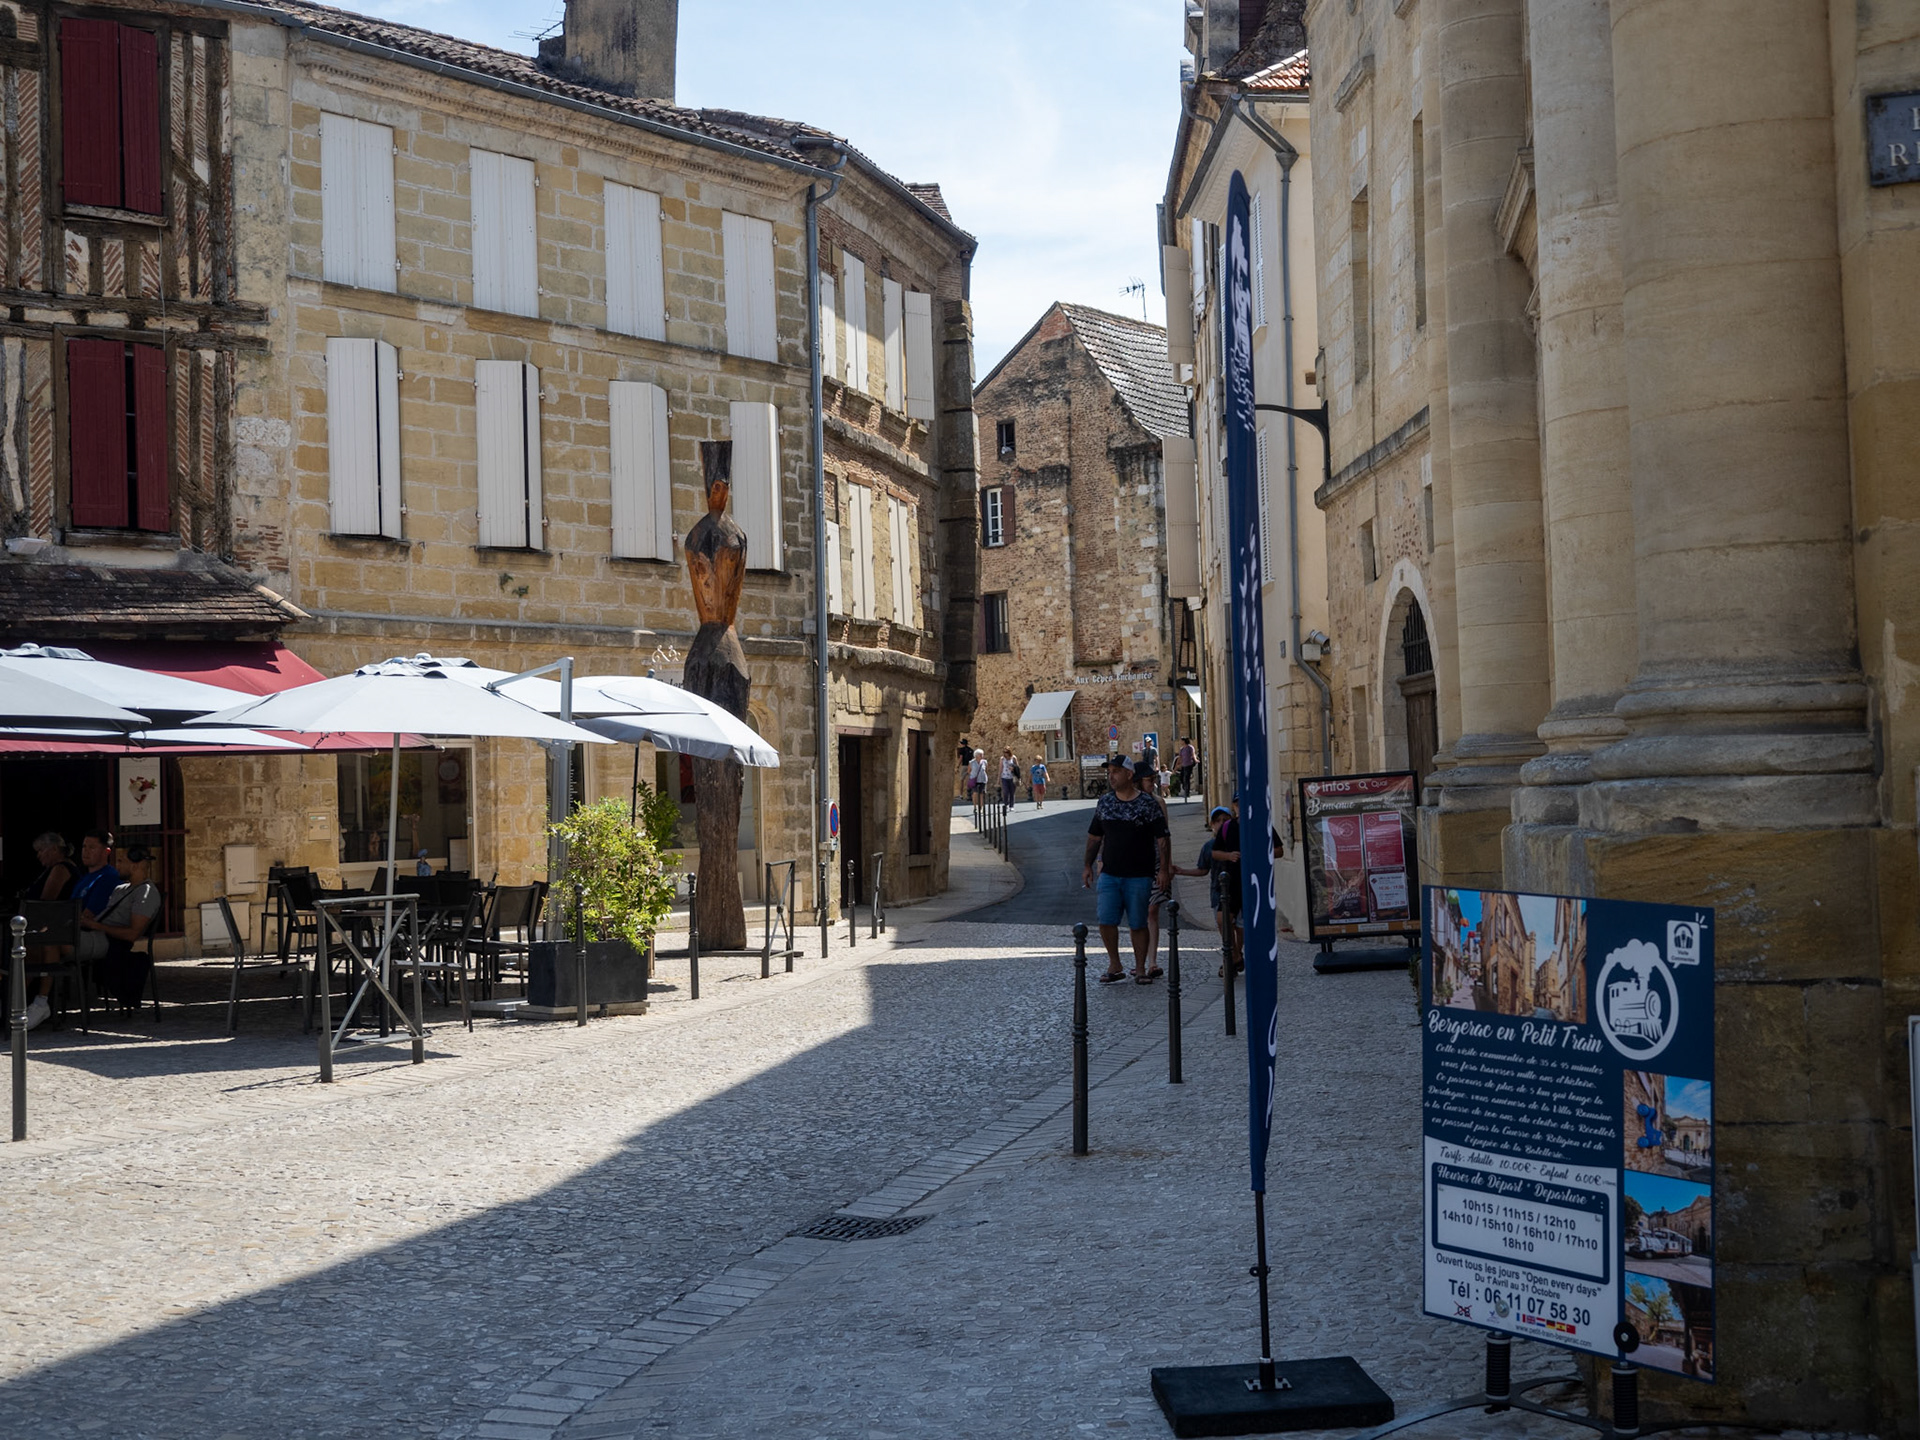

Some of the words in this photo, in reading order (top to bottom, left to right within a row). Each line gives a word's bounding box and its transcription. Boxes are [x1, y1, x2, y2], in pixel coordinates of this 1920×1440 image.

[1428, 1009, 1493, 1043] Bergerac
[1497, 1026, 1515, 1041] en
[1521, 1022, 1557, 1046] Petit
[1562, 1025, 1604, 1053] Train
[1435, 1043, 1455, 1053] Cette
[1457, 1048, 1477, 1056] visite
[1479, 1052, 1524, 1063] commentée
[1526, 1056, 1537, 1064] de
[1570, 1064, 1603, 1075] minutes
[1441, 1061, 1458, 1069] vous
[1460, 1061, 1478, 1072] fera
[1480, 1064, 1515, 1076] traverser
[1516, 1070, 1536, 1079] mille
[1539, 1075, 1553, 1083] ans
[1436, 1072, 1446, 1080] Ce
[1446, 1076, 1482, 1087] parcours
[1484, 1079, 1494, 1088] de
[1495, 1082, 1514, 1092] plus
[1516, 1084, 1526, 1093] de
[1536, 1087, 1550, 1096] km
[1552, 1092, 1567, 1101] qui
[1568, 1092, 1591, 1106] longe
[1594, 1096, 1603, 1105] la
[1432, 1100, 1440, 1109] la
[1443, 1102, 1469, 1113] Guerre
[1471, 1107, 1481, 1115] de
[1518, 1114, 1530, 1123] du
[1560, 1121, 1575, 1131] des
[1578, 1124, 1616, 1138] Récollets
[1471, 1094, 1489, 1102] vous
[1528, 1101, 1538, 1110] de
[1541, 1103, 1550, 1112] la
[1553, 1105, 1572, 1115] Villa
[1575, 1108, 1612, 1121] Romaine
[1442, 1119, 1474, 1131] passant
[1472, 1122, 1489, 1132] par
[1491, 1124, 1500, 1133] la
[1502, 1126, 1529, 1138] Guerre
[1532, 1132, 1542, 1140] de
[1546, 1134, 1580, 1148] Religion
[1582, 1140, 1592, 1148] et
[1593, 1142, 1604, 1151] de
[1500, 1141, 1510, 1149] de
[1512, 1143, 1521, 1152] la
[1467, 1152, 1493, 1166] Adulte
[1499, 1160, 1531, 1173] 10.00€
[1539, 1164, 1569, 1181] Enfant
[1437, 1165, 1469, 1183] Heures
[1471, 1172, 1483, 1185] de
[1487, 1174, 1523, 1193] Départ
[1534, 1183, 1586, 1204] Departure
[1442, 1209, 1473, 1225] 14h10
[1482, 1218, 1513, 1233] 15h10
[1523, 1226, 1555, 1242] 16h10
[1565, 1234, 1598, 1250] 17h10
[1462, 1199, 1493, 1214] 10h15
[1503, 1206, 1534, 1222] 11h15
[1543, 1215, 1576, 1231] 12h10
[1502, 1236, 1534, 1253] 18h10
[1436, 1252, 1463, 1268] Ouvert
[1465, 1259, 1483, 1272] tous
[1485, 1263, 1497, 1275] les
[1498, 1266, 1520, 1280] jours
[1551, 1279, 1574, 1294] every
[1475, 1272, 1485, 1283] Du
[1492, 1277, 1508, 1288] Avril
[1510, 1282, 1519, 1290] au
[1521, 1283, 1529, 1292] 31
[1531, 1286, 1561, 1300] Octobre
[1448, 1279, 1470, 1299] Tél
[1484, 1287, 1501, 1308] 06
[1506, 1292, 1521, 1310] 11
[1527, 1297, 1545, 1315] 07
[1550, 1302, 1567, 1321] 58
[1573, 1307, 1590, 1326] 30
[1515, 1325, 1592, 1348] www.petit-train-bergerac.com
